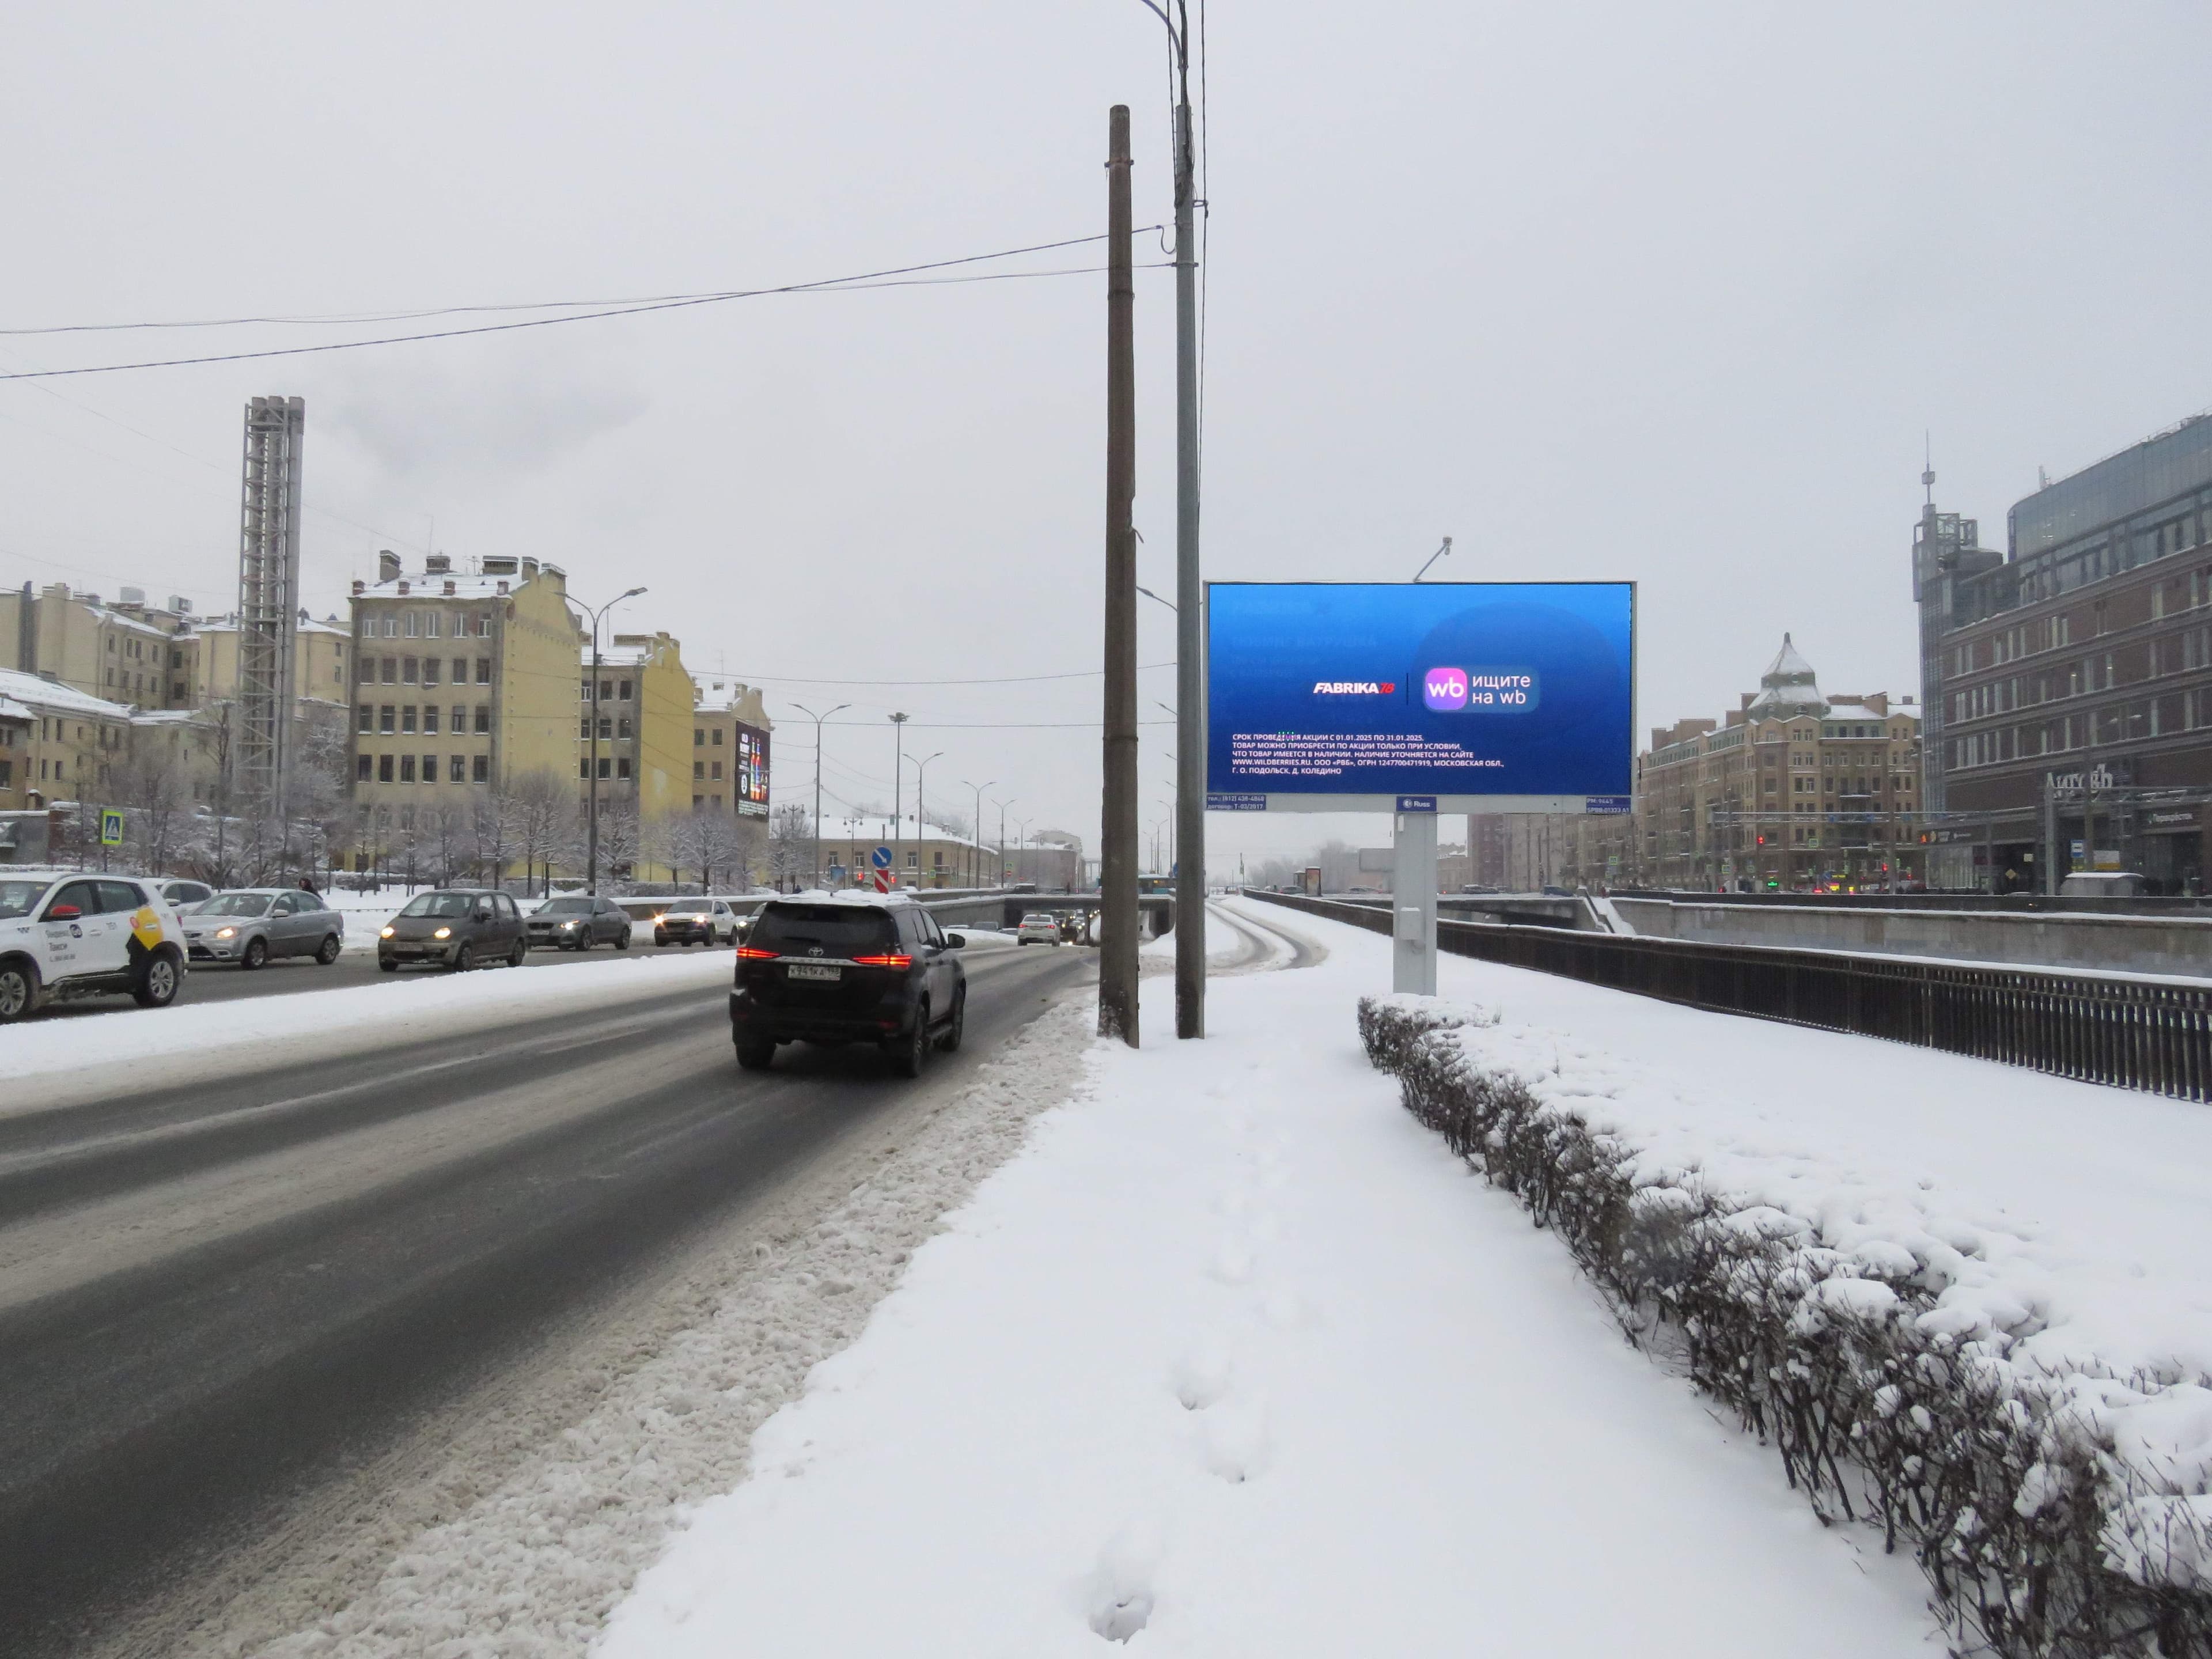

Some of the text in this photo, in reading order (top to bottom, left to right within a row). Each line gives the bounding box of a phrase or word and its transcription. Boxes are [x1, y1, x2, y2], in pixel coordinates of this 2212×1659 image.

[1313, 683, 1395, 694] FABRIKA78
[1428, 677, 1465, 698] wb
[1472, 675, 1531, 690] ищите
[1472, 691, 1526, 704] на wb
